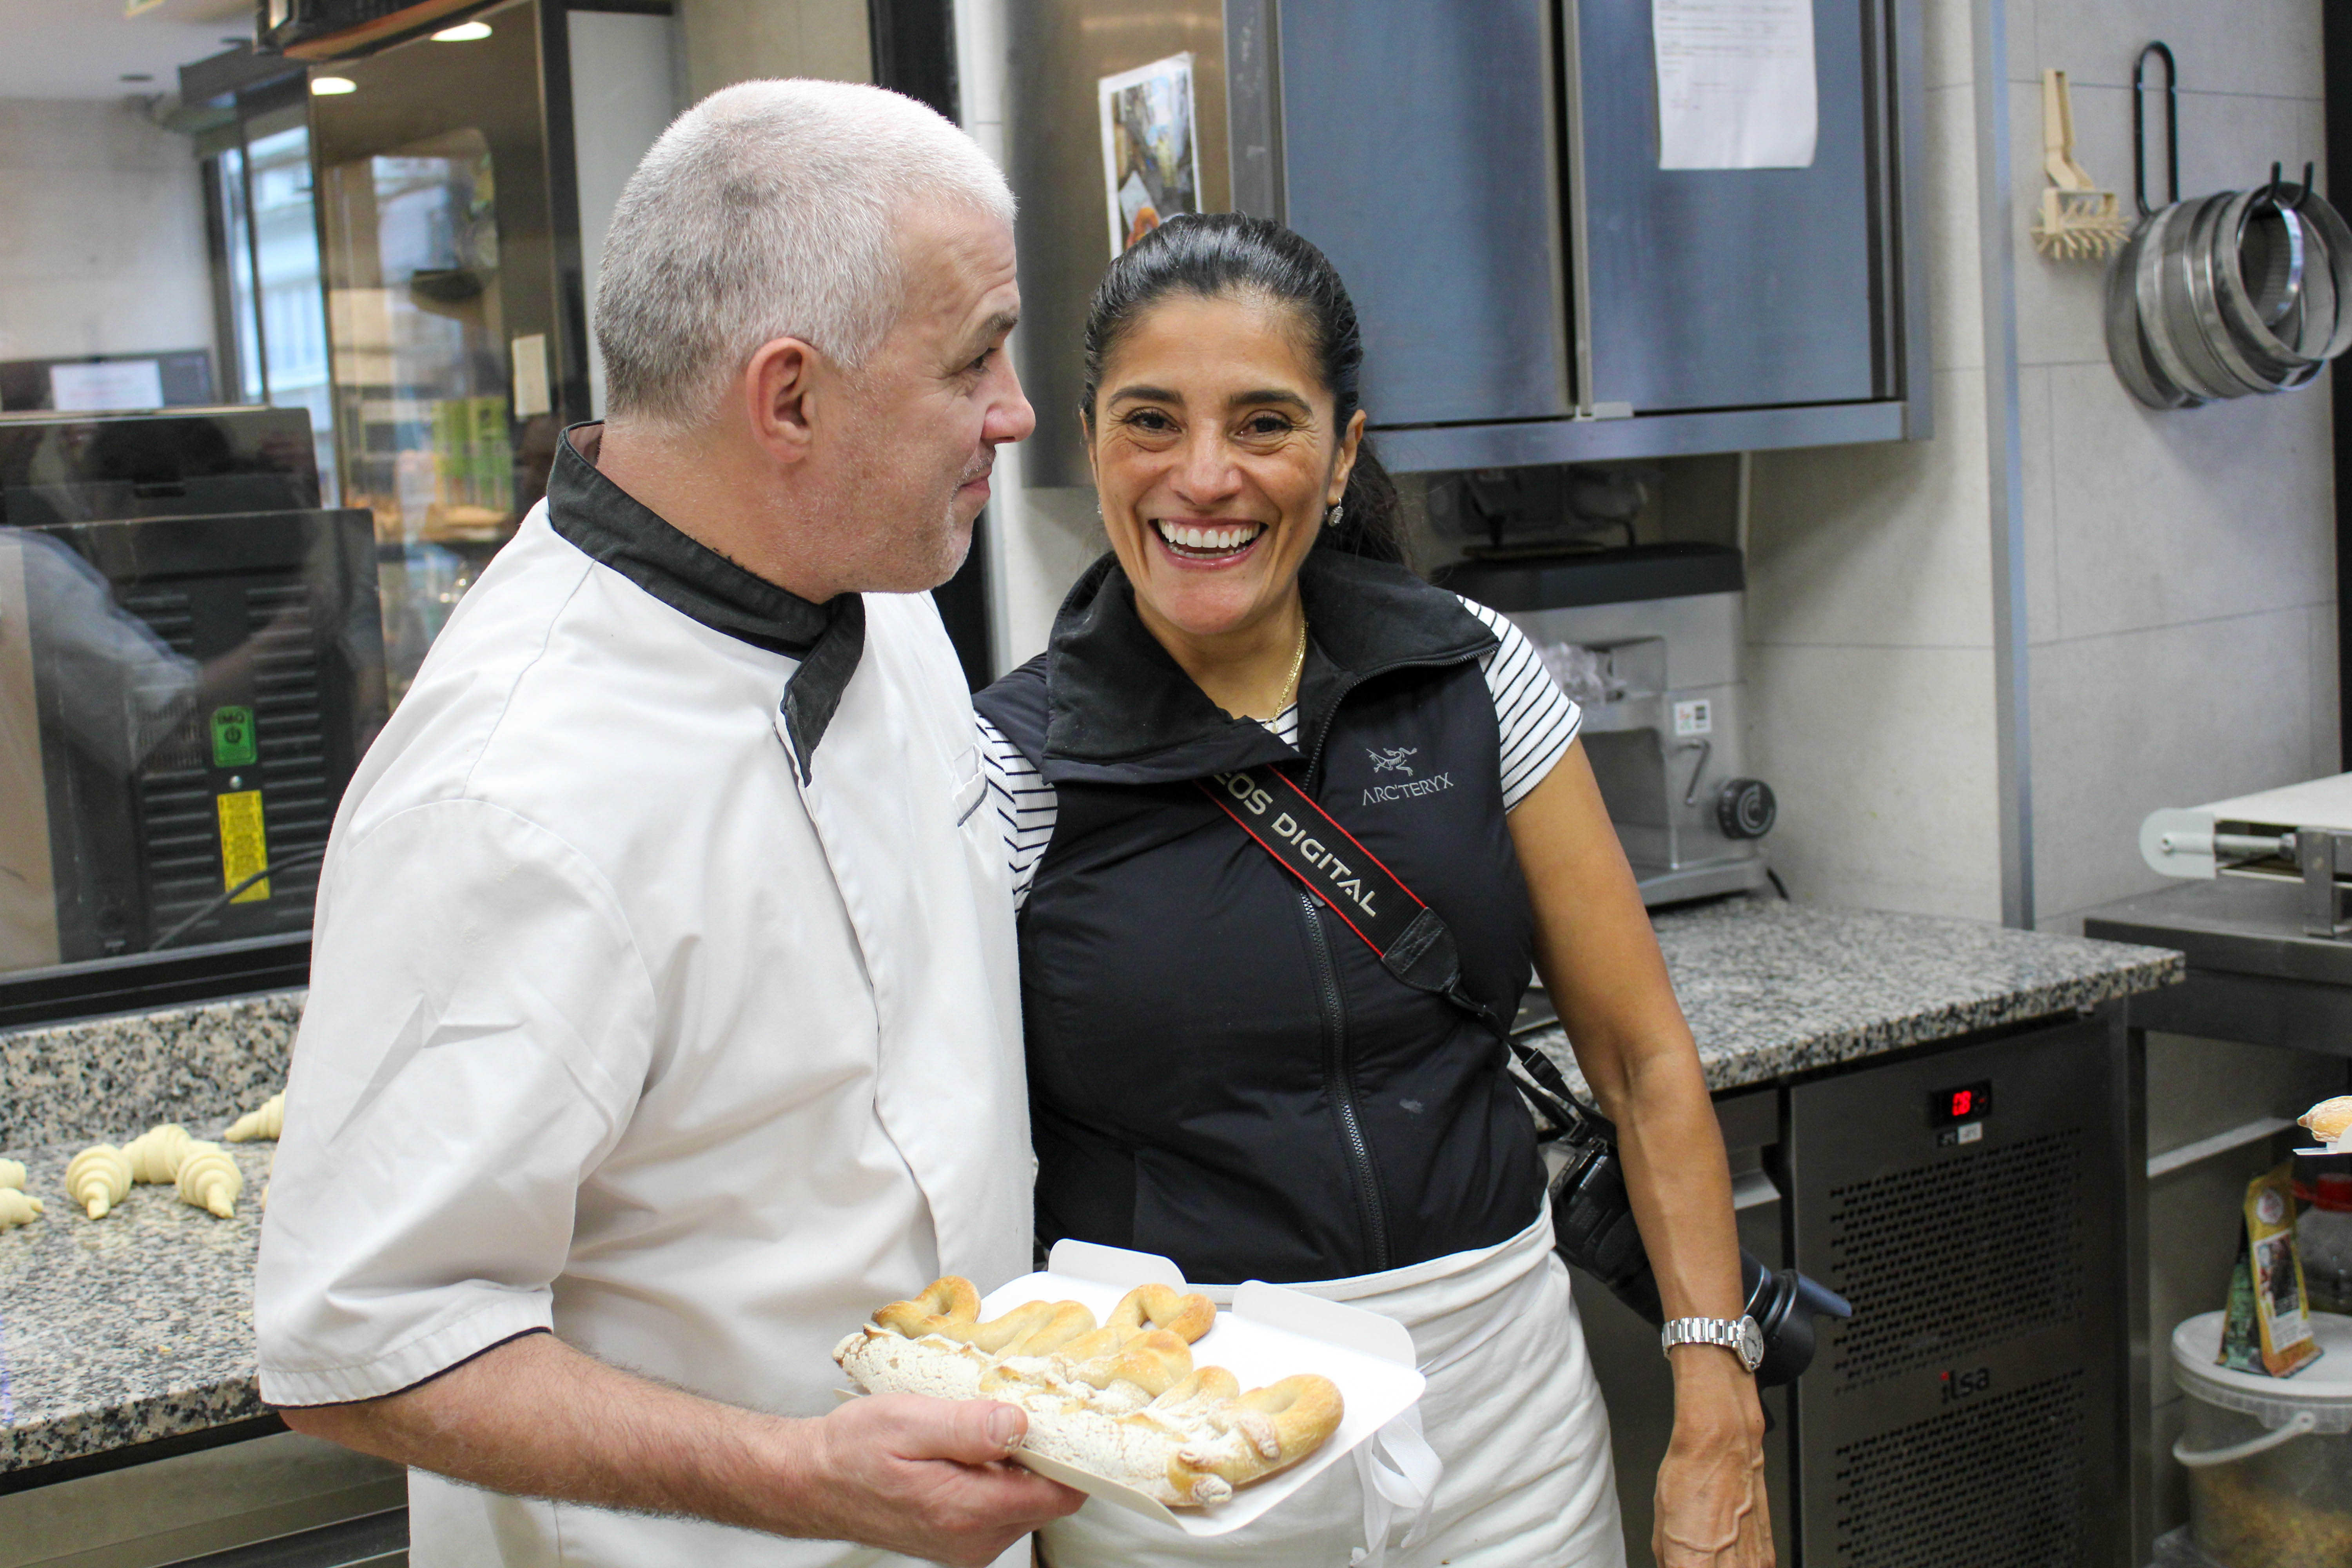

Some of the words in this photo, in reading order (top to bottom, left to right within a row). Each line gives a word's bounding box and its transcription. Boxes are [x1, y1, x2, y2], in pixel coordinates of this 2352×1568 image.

[1362, 771, 1454, 806] ARC'TERYX
[1271, 812, 1376, 917] DIGITAL
[1939, 1367, 1990, 1404] ilsa
